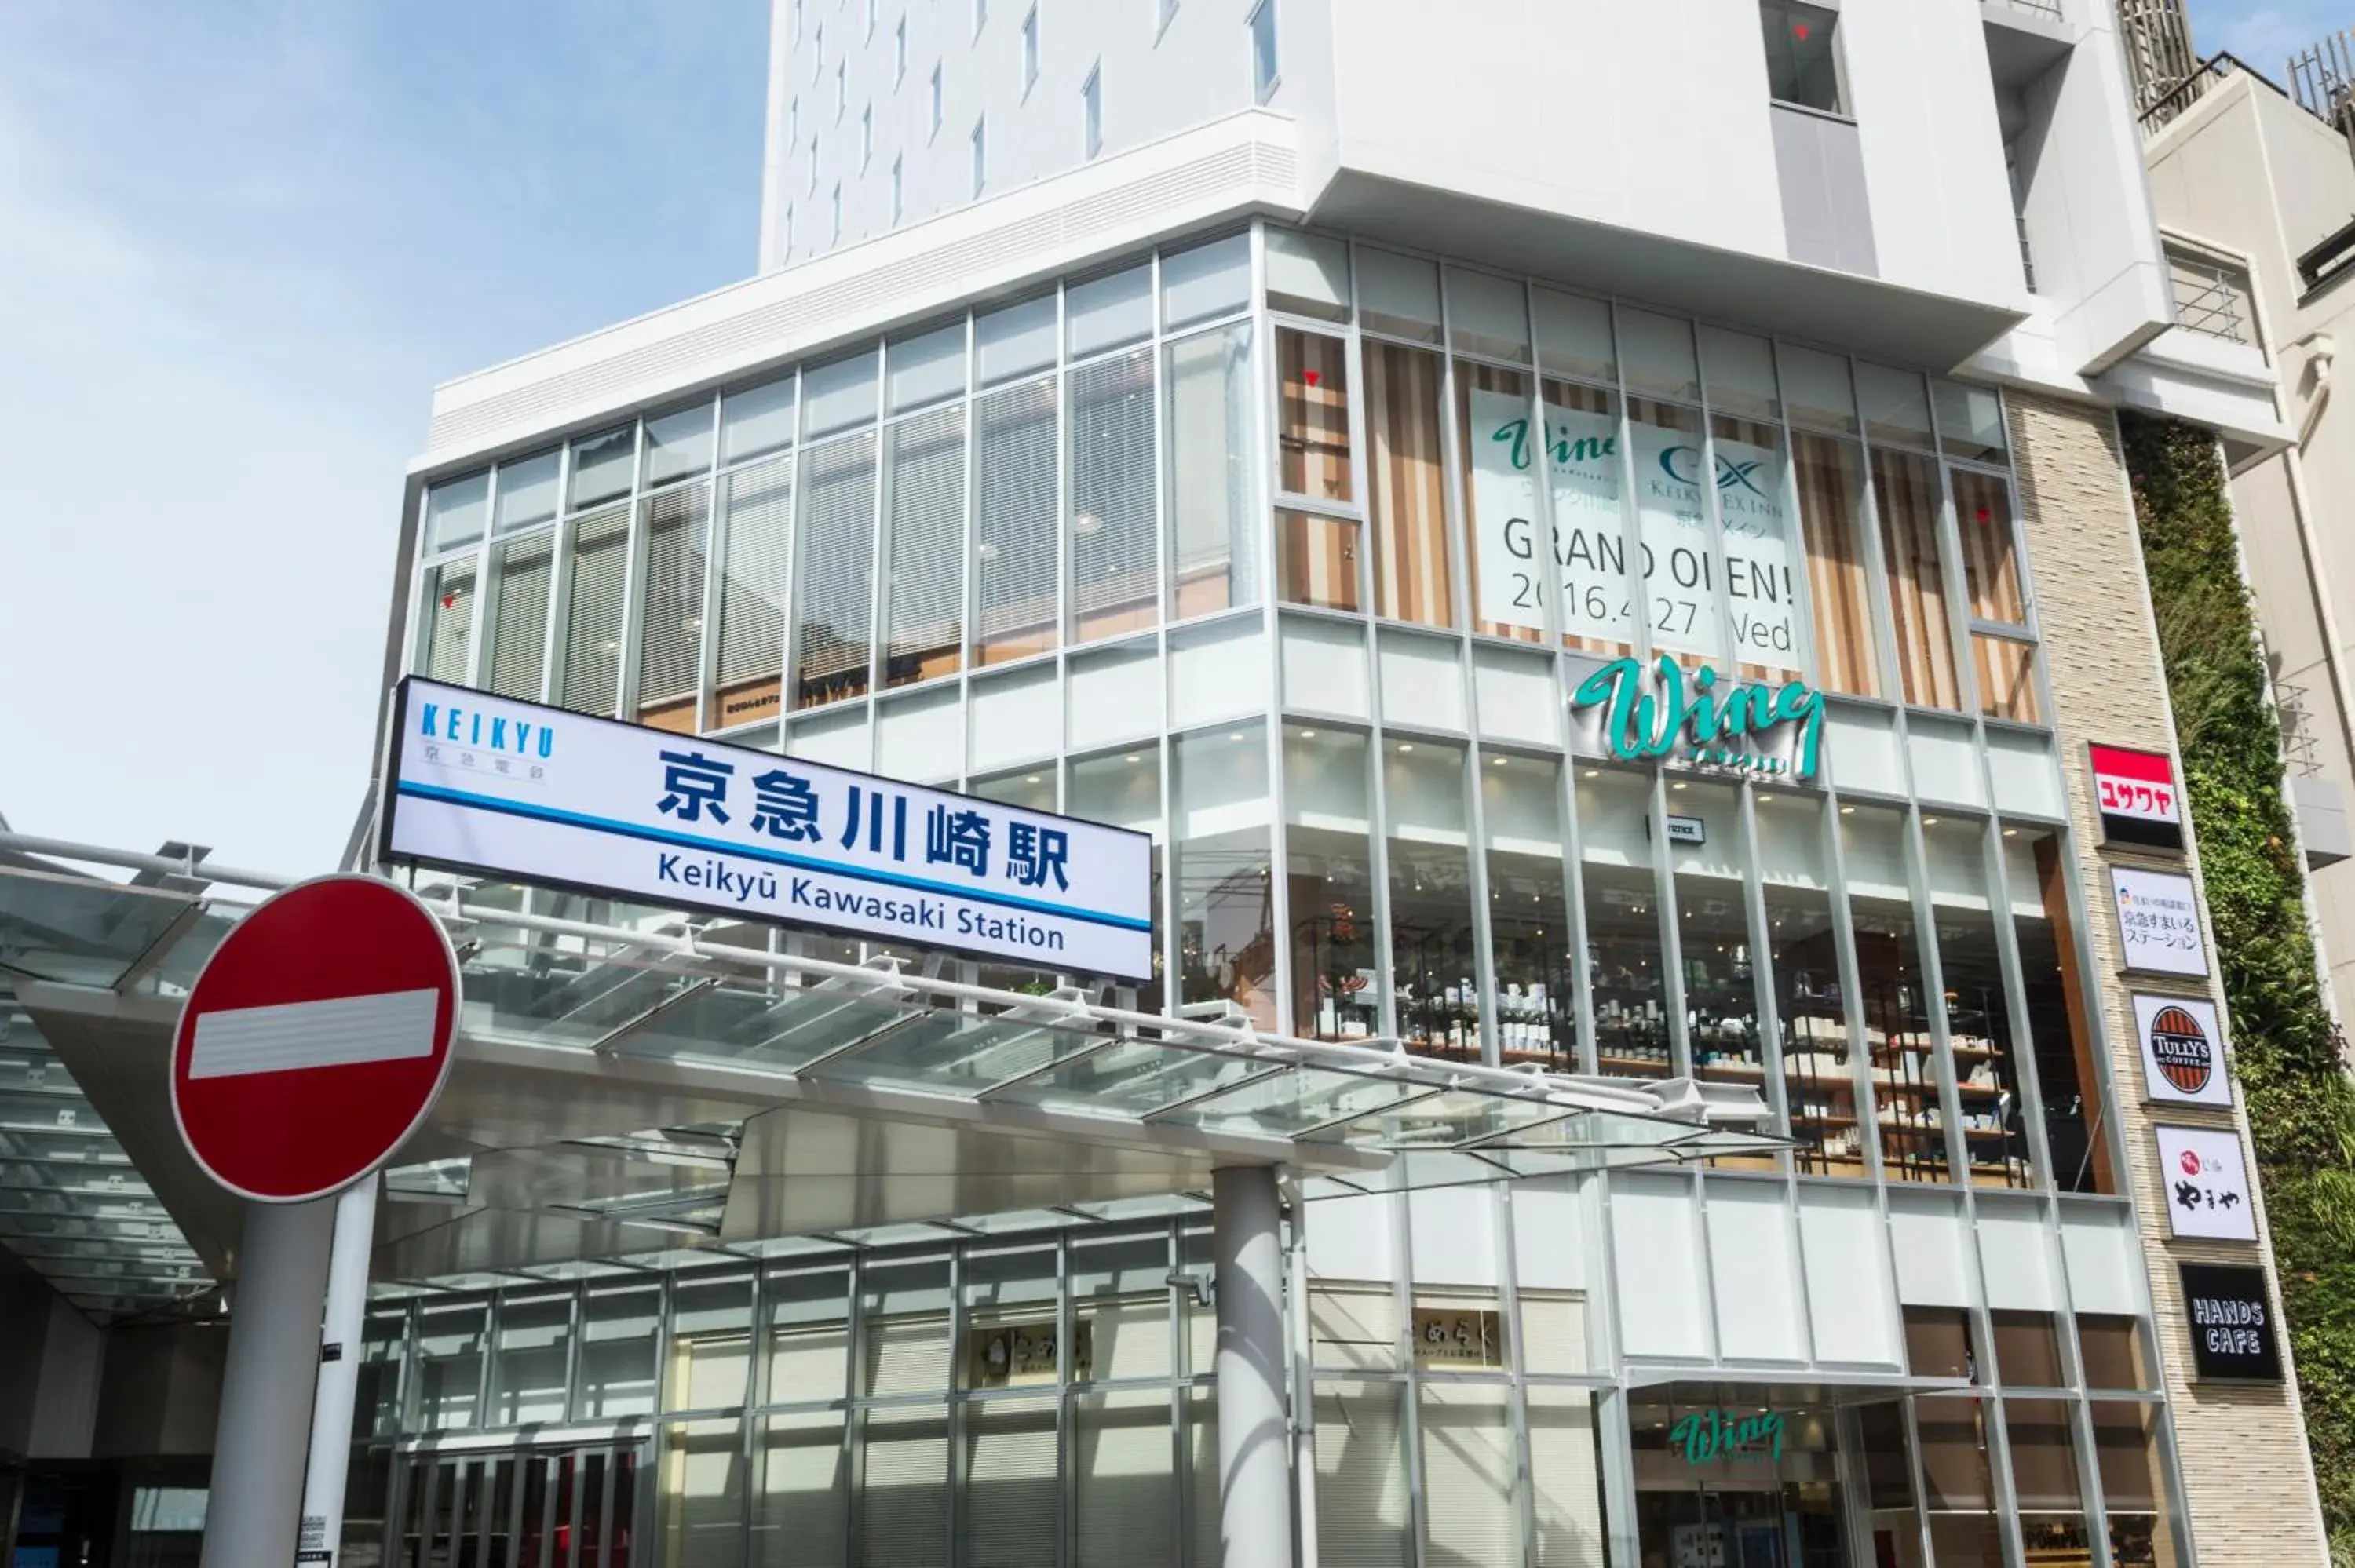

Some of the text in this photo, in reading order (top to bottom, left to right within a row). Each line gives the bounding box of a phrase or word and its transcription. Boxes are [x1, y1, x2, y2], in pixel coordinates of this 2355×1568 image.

[1671, 547, 1793, 605] OEN!
[421, 702, 553, 758] KEIKYU
[1572, 655, 1825, 779] Wing
[656, 749, 1069, 893] 京急川崎駅
[658, 852, 1064, 950] Keikyū Kawasaki Station
[2126, 928, 2197, 950] ステーション
[2167, 1056, 2200, 1067] COFFEE
[2193, 1297, 2265, 1326] HANDS
[2207, 1327, 2261, 1355] CAFE
[1670, 1409, 1784, 1465] Wing
